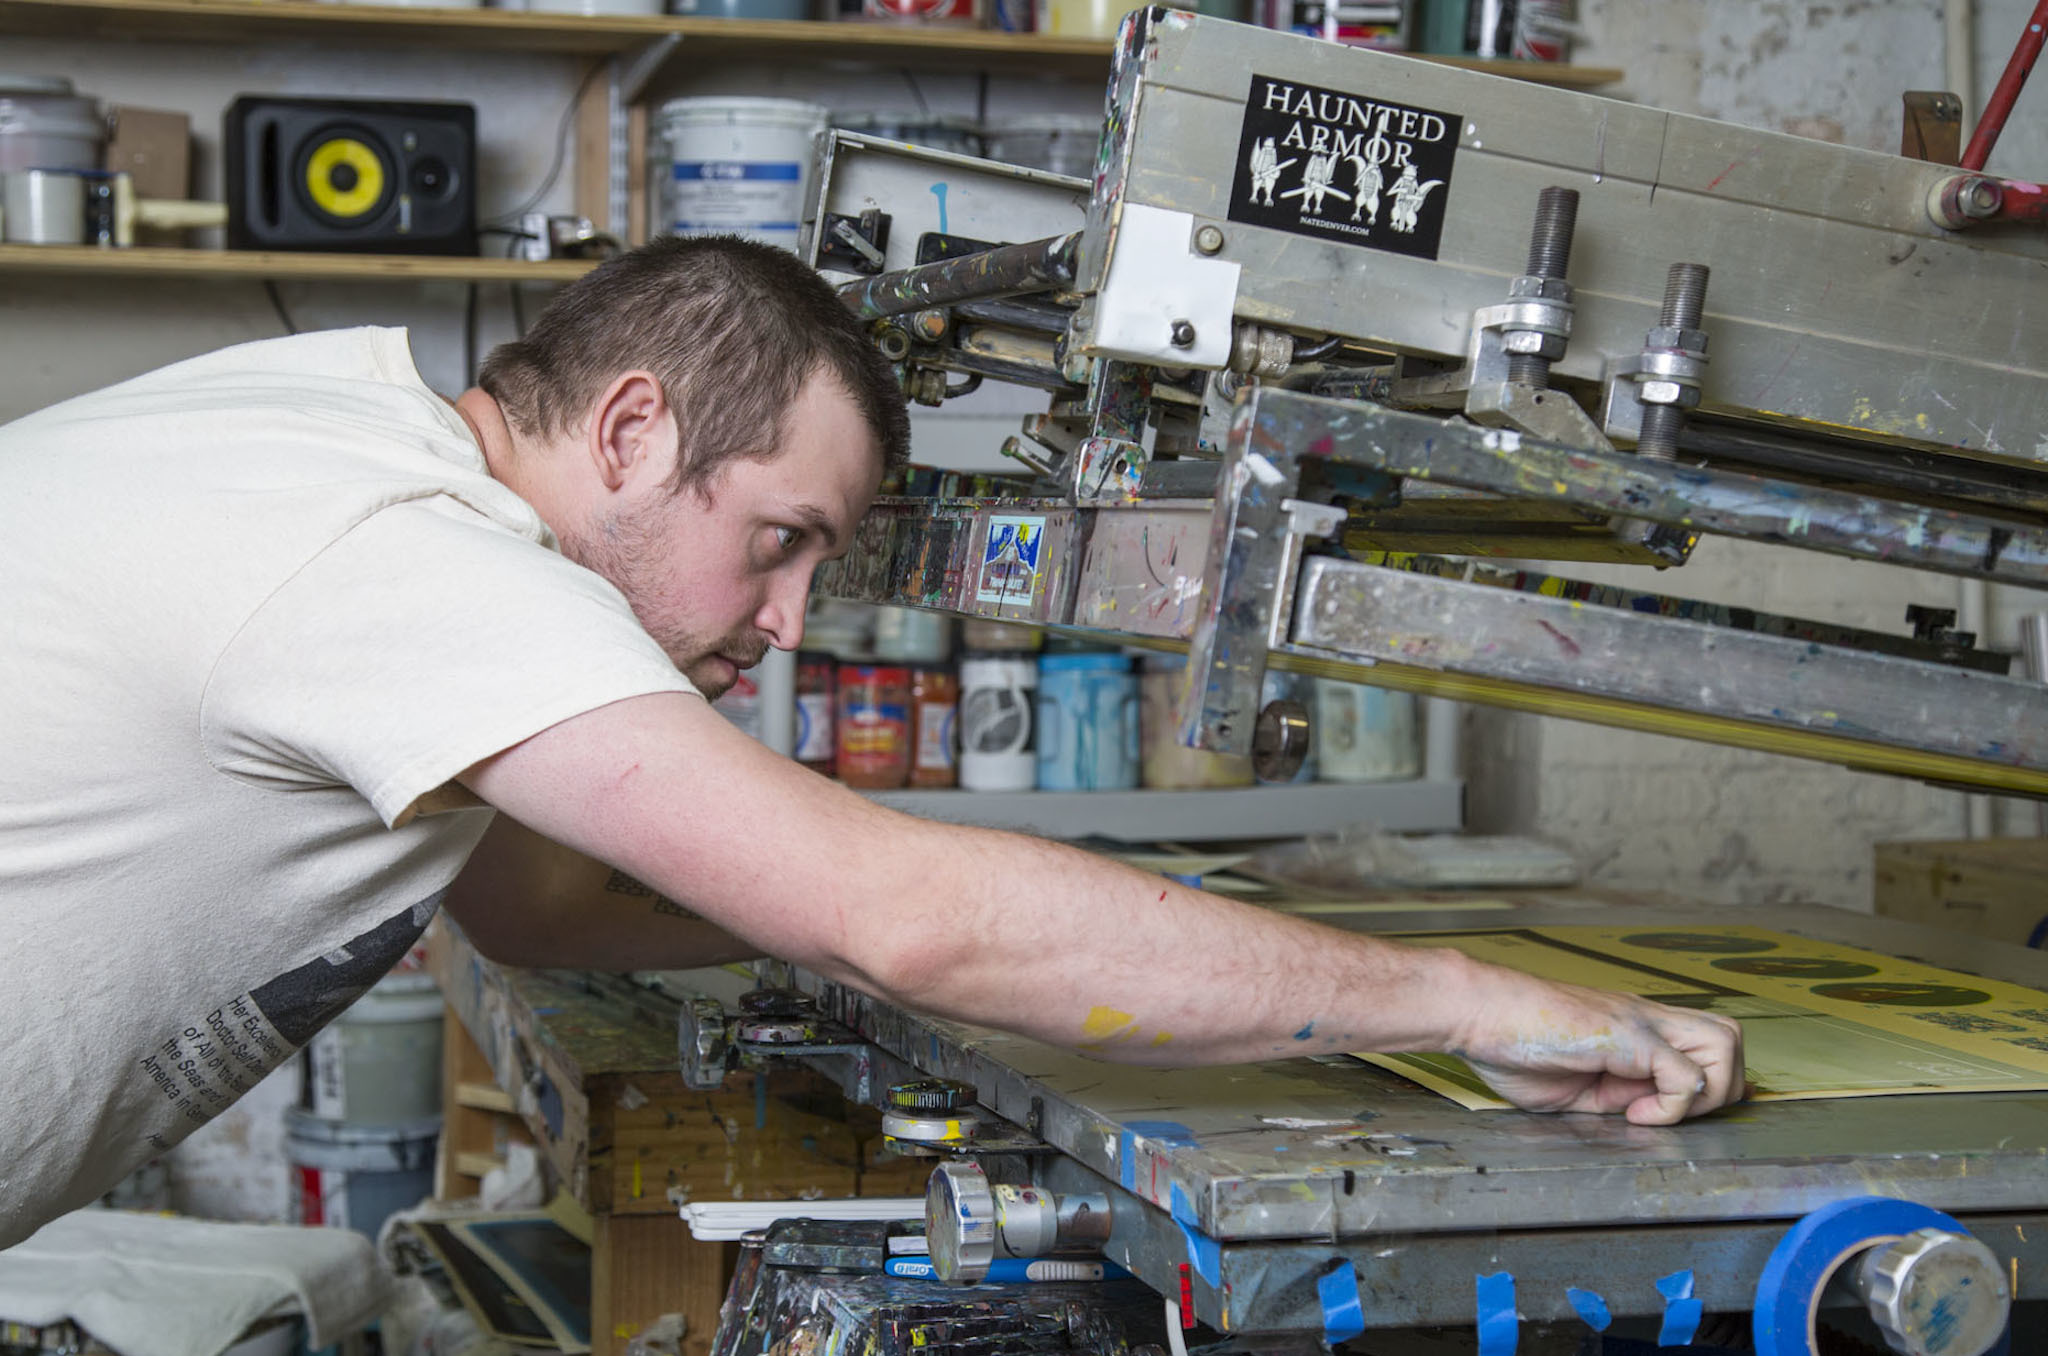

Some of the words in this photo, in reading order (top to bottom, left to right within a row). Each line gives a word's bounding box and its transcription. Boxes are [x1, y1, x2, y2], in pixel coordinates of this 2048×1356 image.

[1263, 83, 1446, 142] HAUNTED
[1281, 120, 1412, 168] ARMOR
[1299, 216, 1370, 236] NATEDENVER.COM
[227, 995, 250, 1019] Her
[183, 1026, 205, 1041] of
[194, 1041, 216, 1060] All
[206, 1009, 238, 1048] Doctor
[139, 1055, 181, 1100] America
[161, 1037, 183, 1061] the
[177, 1059, 206, 1089] Seas
